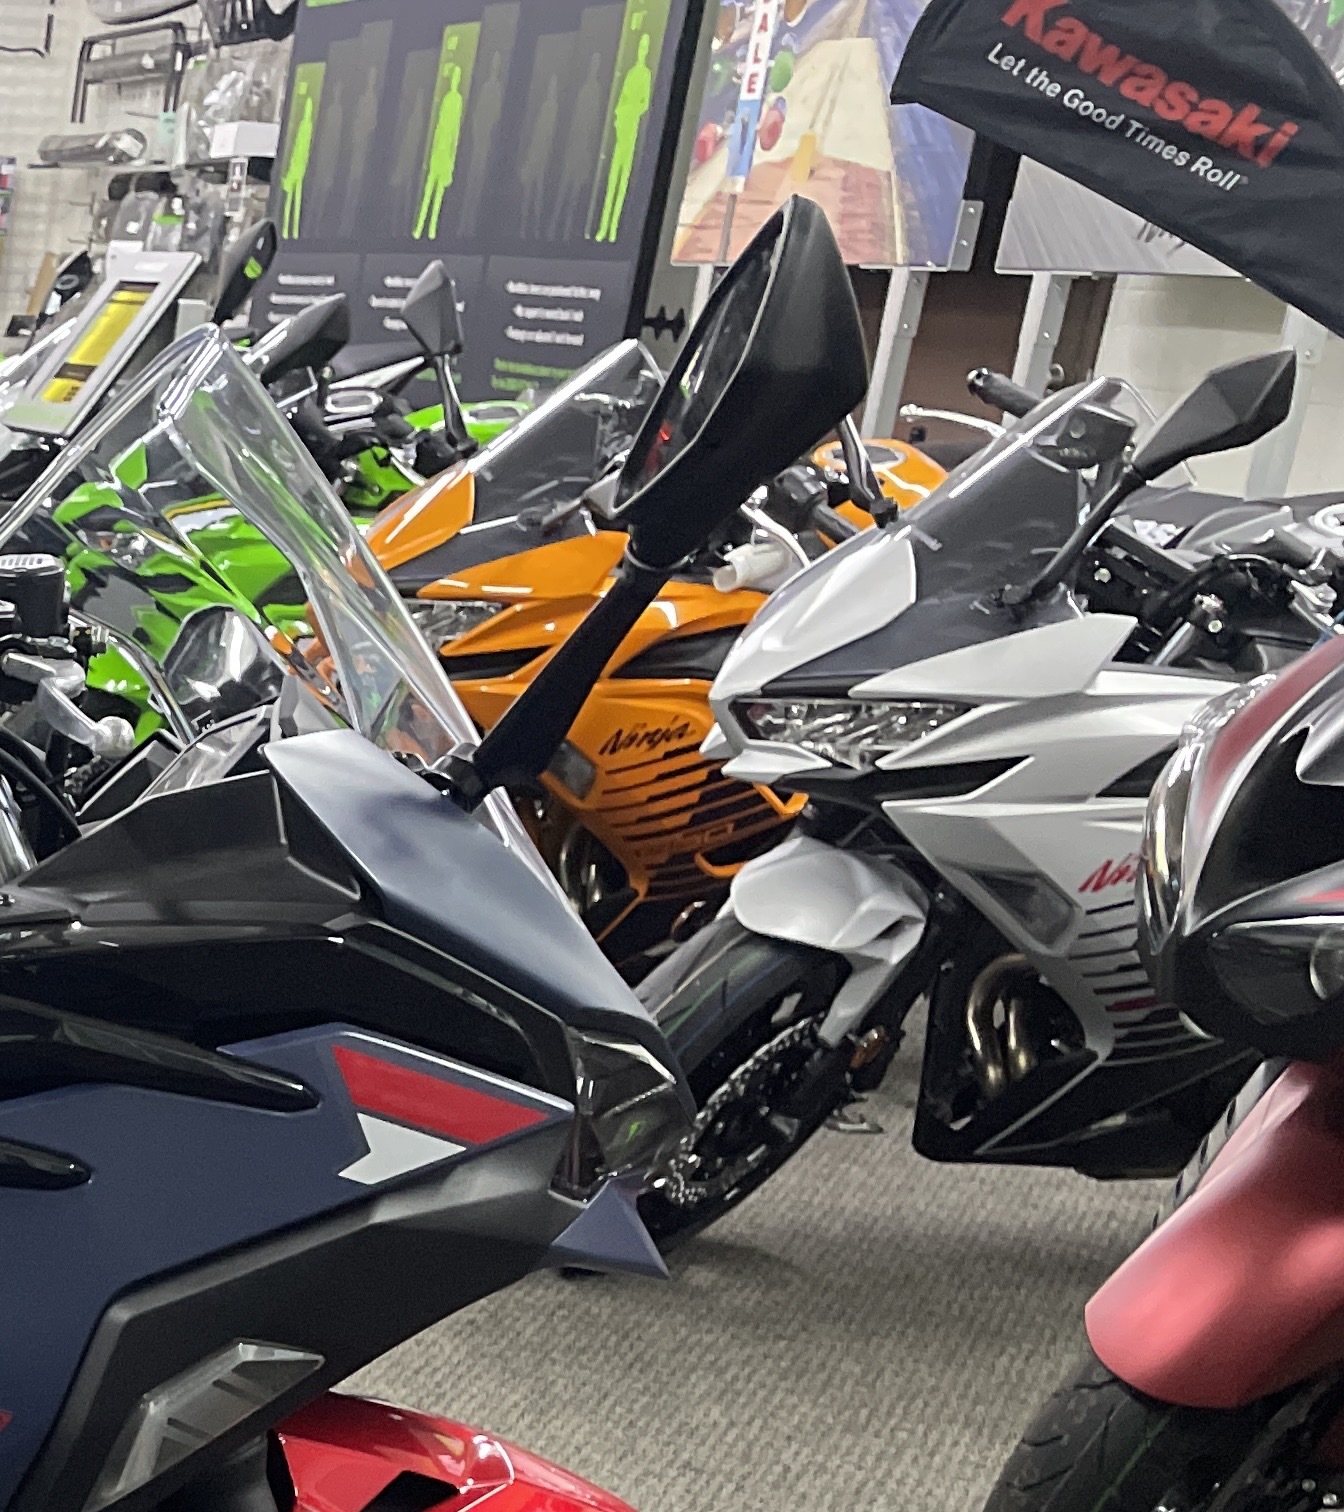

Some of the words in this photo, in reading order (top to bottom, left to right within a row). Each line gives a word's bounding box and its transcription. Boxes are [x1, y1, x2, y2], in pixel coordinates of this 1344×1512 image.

[747, 0, 772, 94] ALE
[1002, 0, 1300, 168] Kawasaki
[987, 42, 1027, 76] Let
[1025, 66, 1062, 97] the
[1062, 88, 1125, 130] Good
[1124, 119, 1191, 166] Times
[598, 715, 697, 755] Ninja
